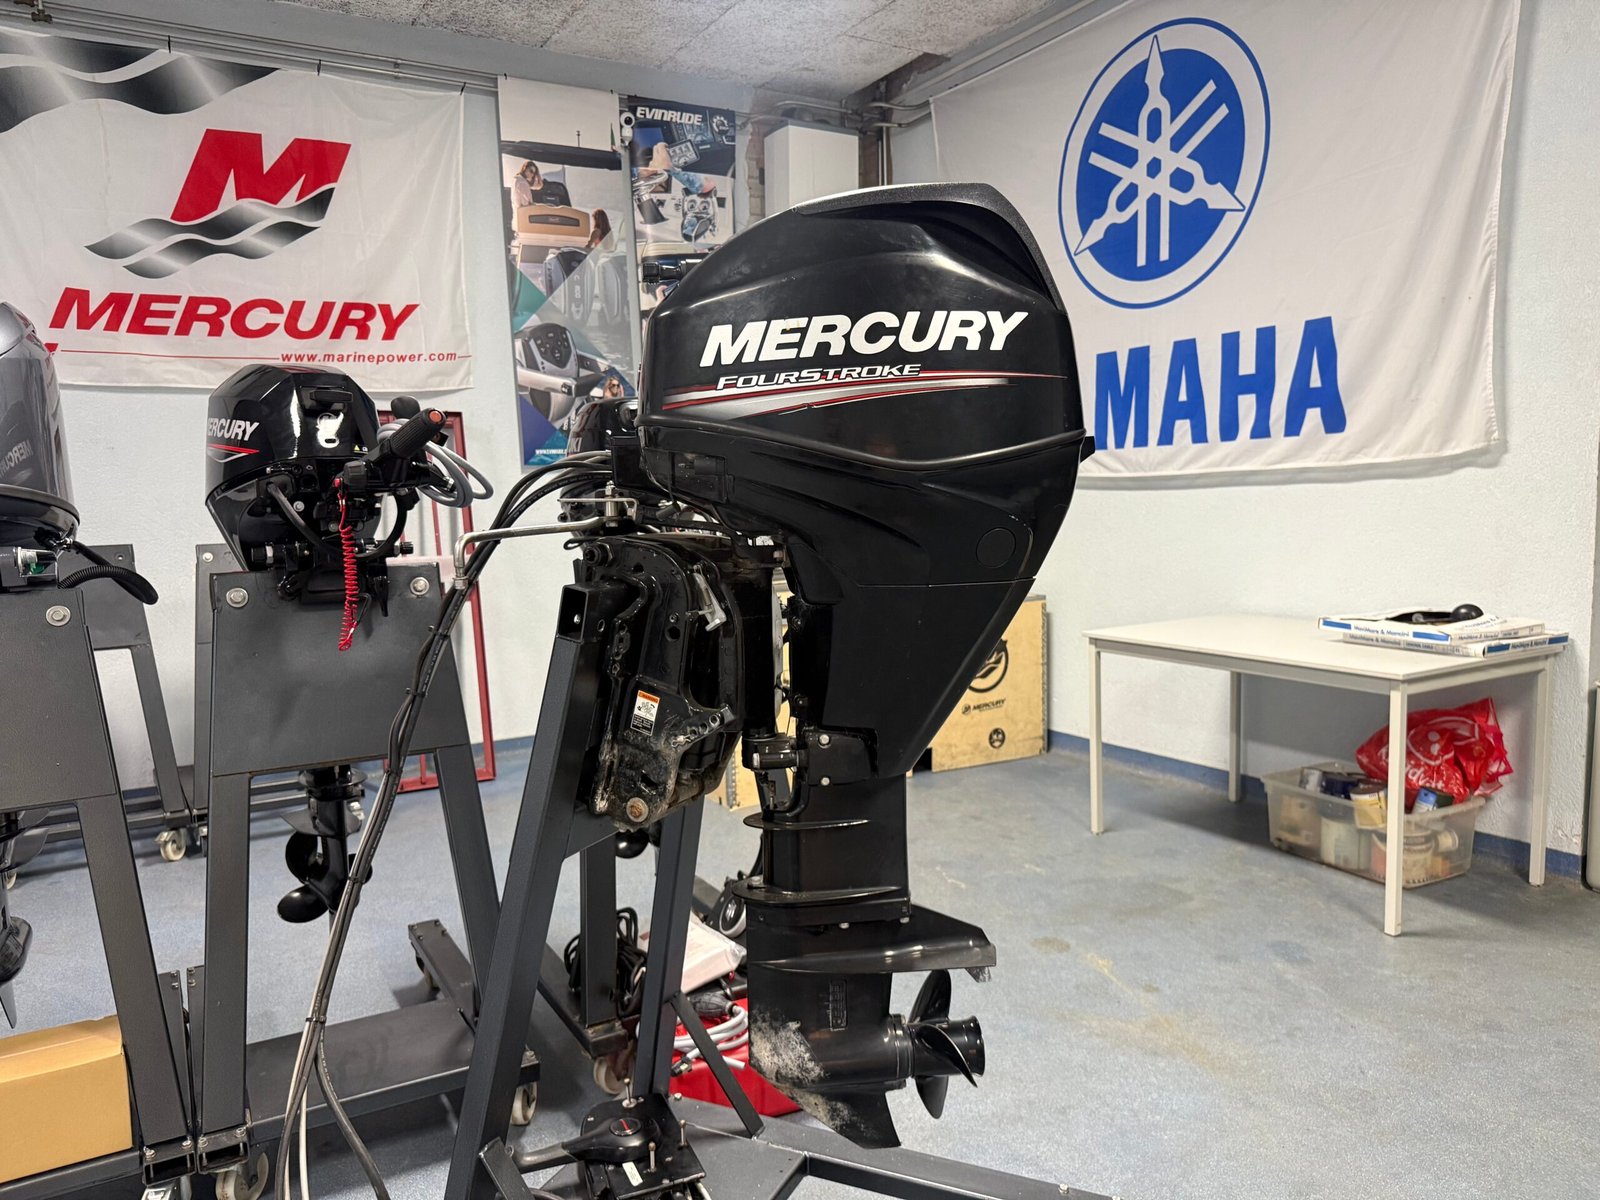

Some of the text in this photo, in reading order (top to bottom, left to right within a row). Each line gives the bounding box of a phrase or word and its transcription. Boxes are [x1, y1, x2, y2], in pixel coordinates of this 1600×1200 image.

[636, 106, 703, 125] EVINRUDE
[48, 287, 420, 341] MERCURY
[281, 352, 457, 365] www.marinepower.com
[699, 310, 1029, 368] MERCURY
[716, 363, 922, 390] FOURSTROKE
[1094, 316, 1347, 451] MAHA
